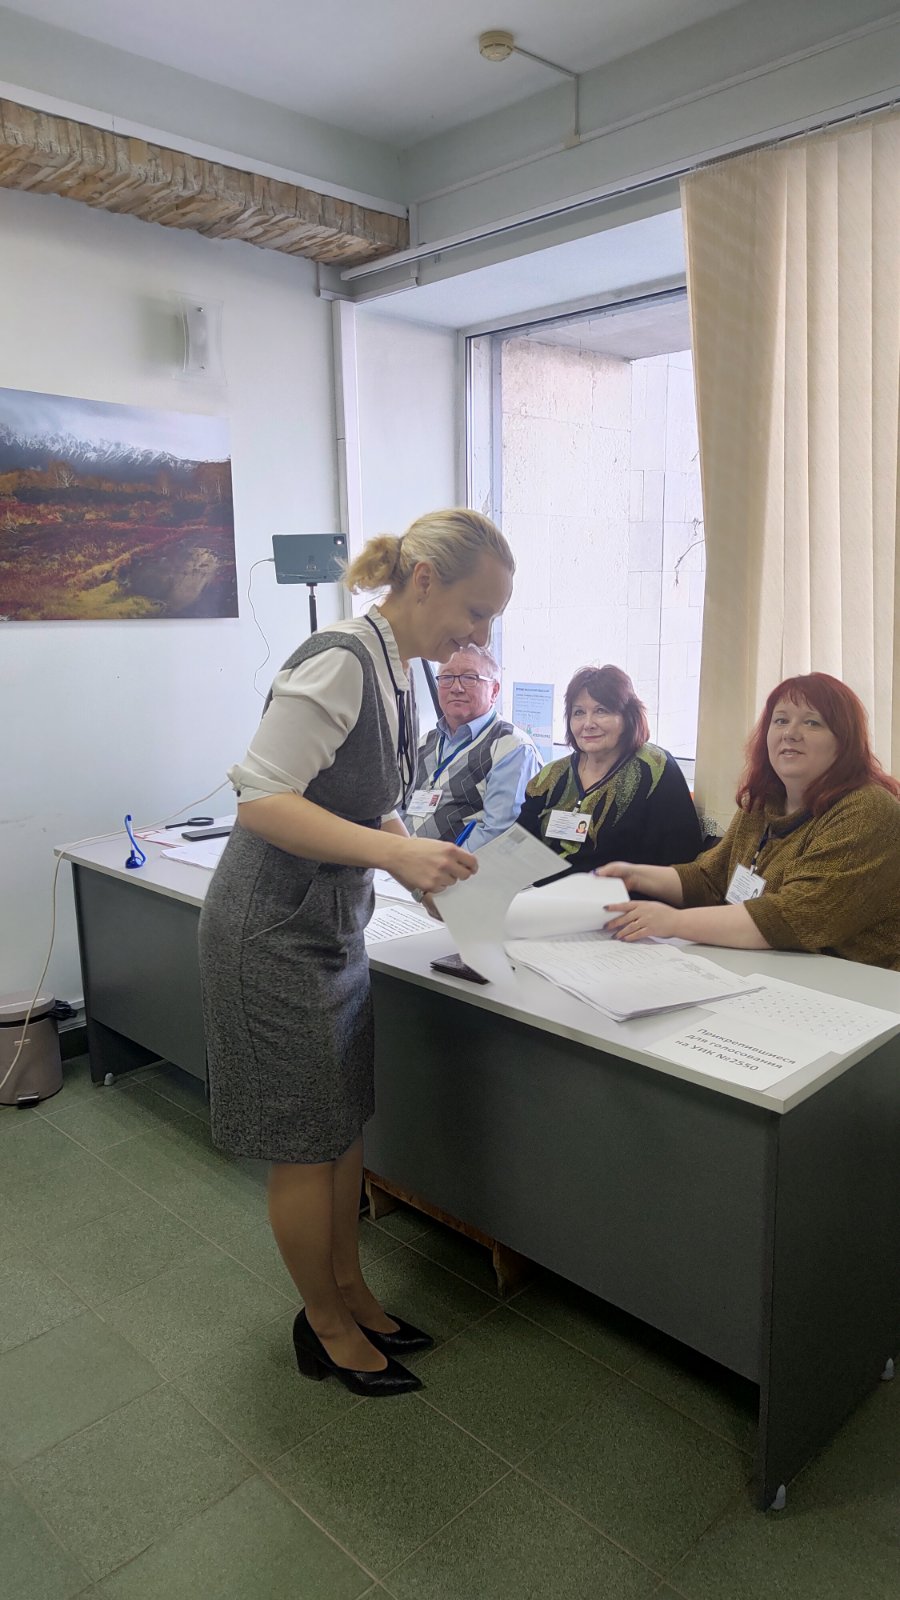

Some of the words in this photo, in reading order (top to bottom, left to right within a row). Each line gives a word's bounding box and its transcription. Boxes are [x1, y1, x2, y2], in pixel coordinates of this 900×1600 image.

[685, 1034, 708, 1043] для
[709, 1042, 783, 1069] голосования
[691, 1044, 716, 1056] УИК
[697, 1028, 796, 1065] Прикрепившиеся
